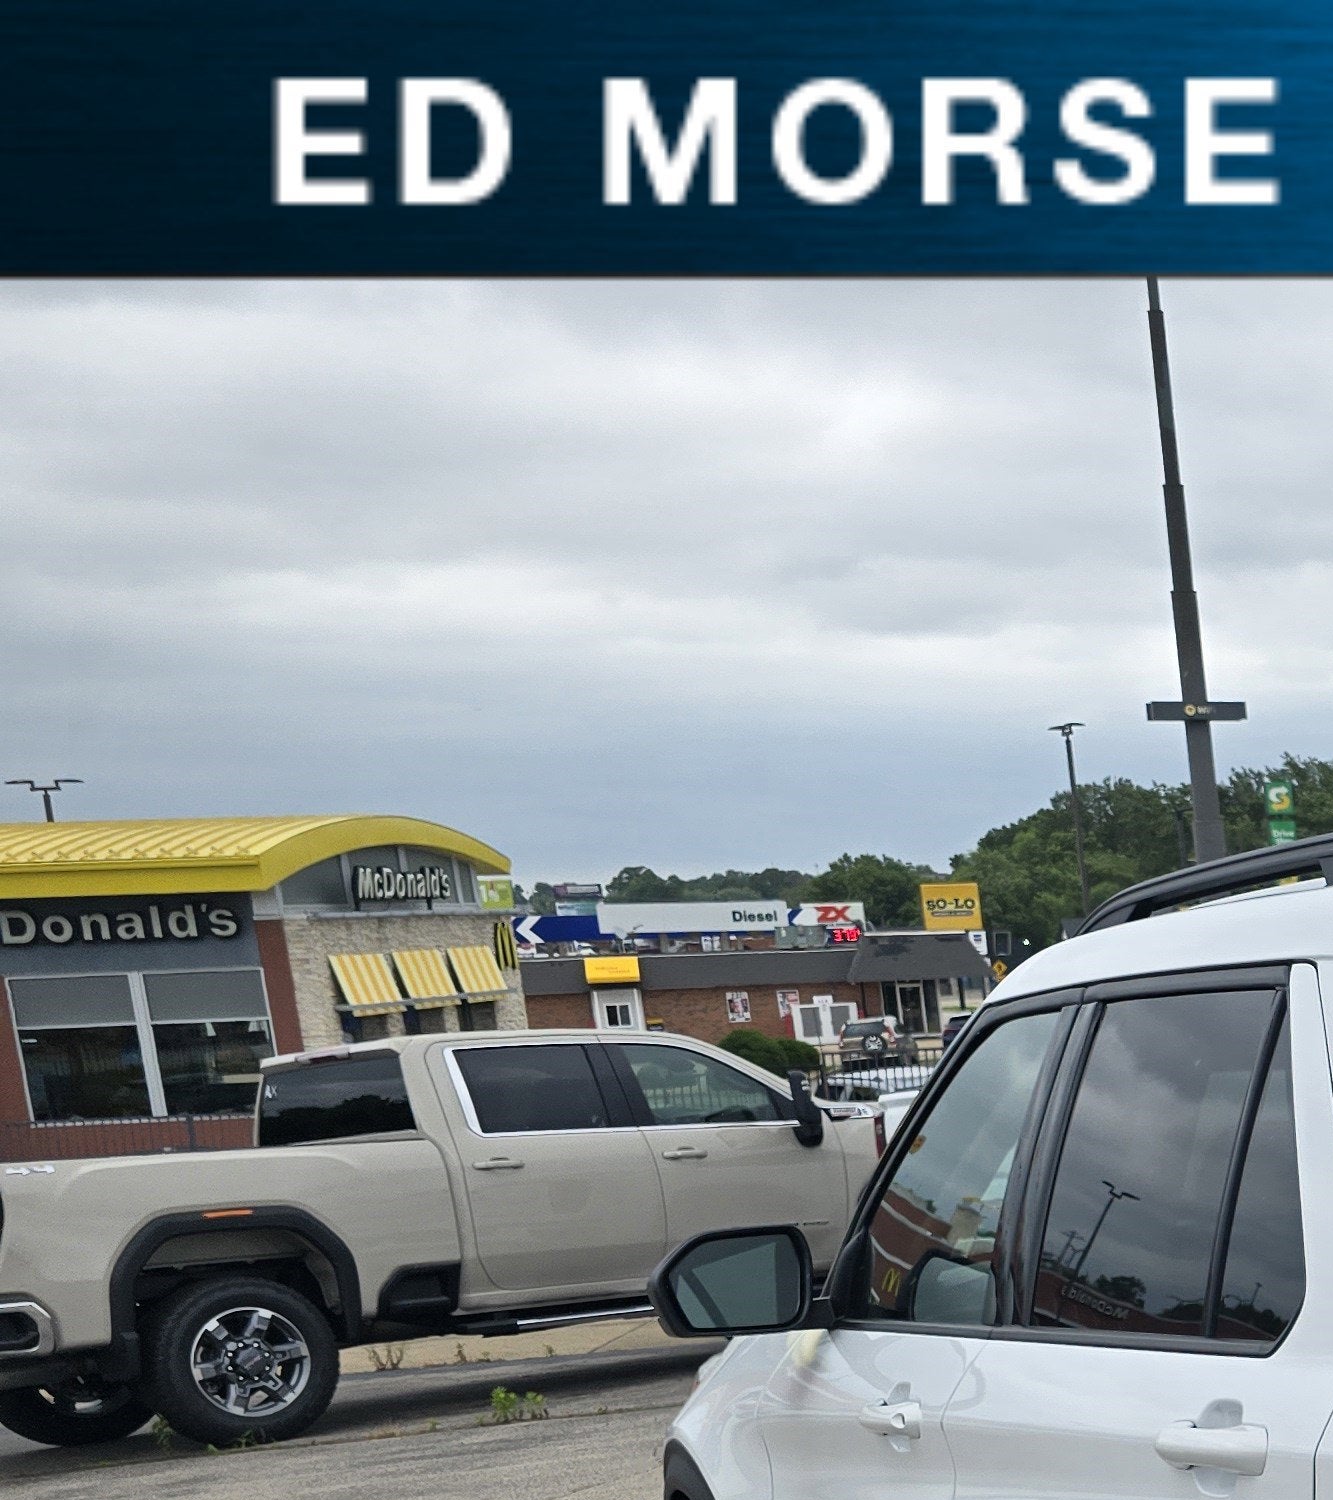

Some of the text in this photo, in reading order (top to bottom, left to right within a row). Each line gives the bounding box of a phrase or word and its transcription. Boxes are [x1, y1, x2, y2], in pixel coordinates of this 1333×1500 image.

[358, 867, 451, 899] McDonald's
[732, 909, 778, 923] Diesel
[926, 898, 976, 911] SO-LO
[0, 903, 238, 945] Donald's
